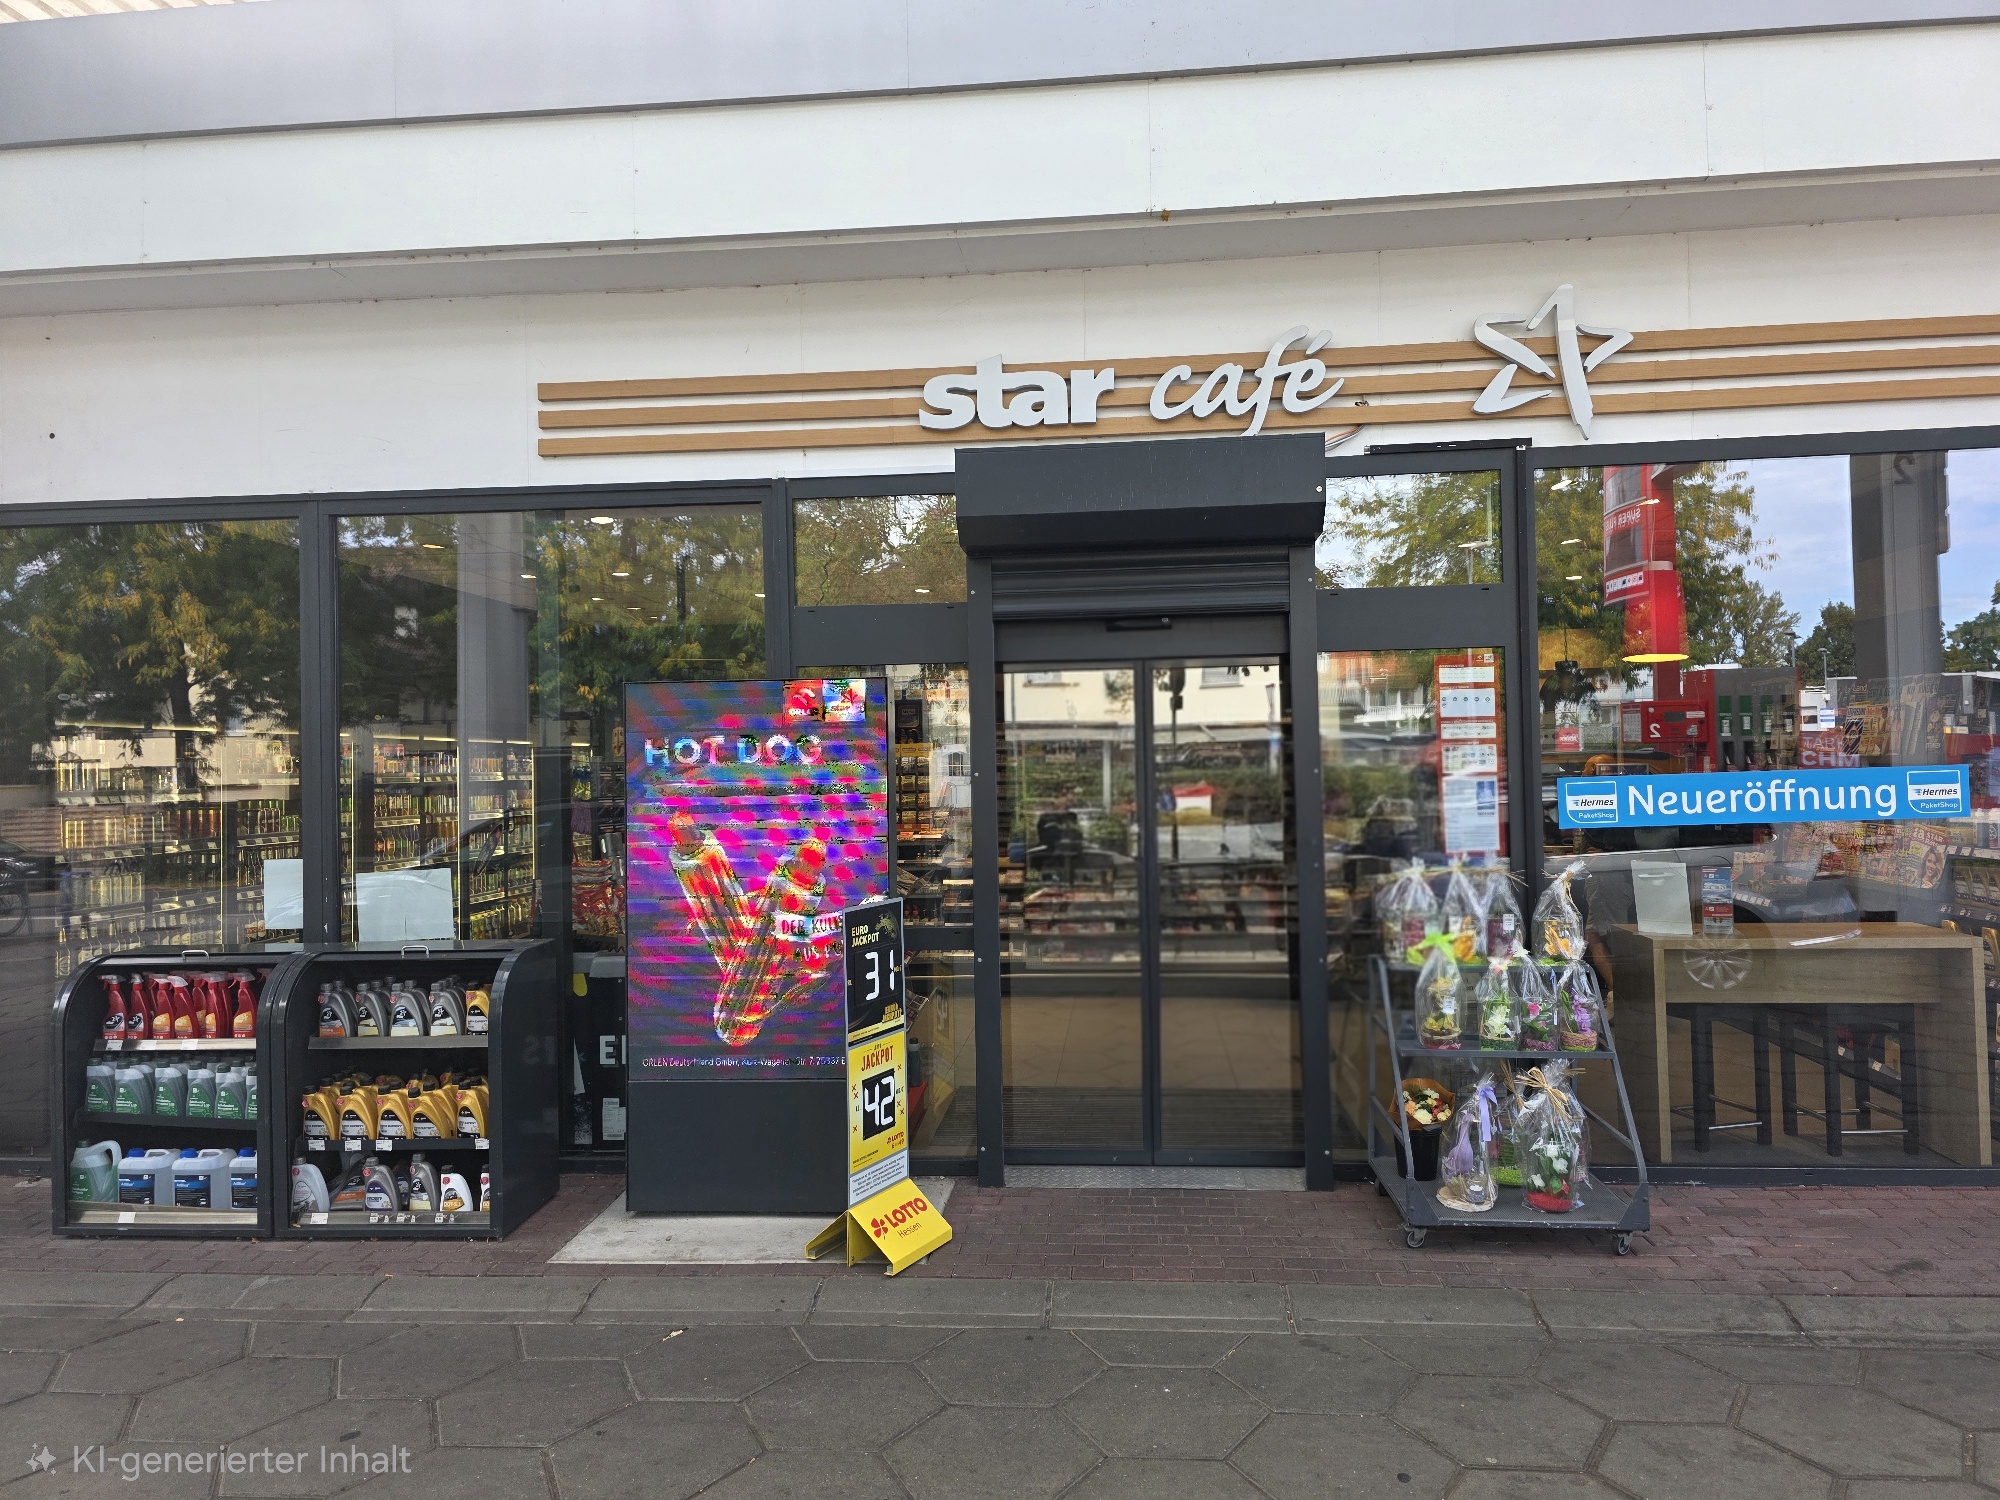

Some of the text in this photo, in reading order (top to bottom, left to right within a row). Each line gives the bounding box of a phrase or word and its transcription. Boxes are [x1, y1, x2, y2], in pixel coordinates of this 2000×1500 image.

[919, 325, 1345, 437] star café
[645, 734, 825, 766] HOT DOG
[1581, 798, 1614, 808] Hermes
[1627, 778, 1897, 818] Neueröffnung
[1922, 787, 1958, 797] Hermes
[1578, 811, 1615, 820] PaketShop
[1920, 801, 1959, 809] PaketShop
[851, 924, 869, 937] EURO
[851, 932, 880, 948] JACKPOT
[865, 949, 895, 1001] 31
[861, 1045, 894, 1072] JACKPOT
[864, 1075, 895, 1127] 42
[883, 1197, 928, 1229] LOTTO
[896, 1222, 923, 1239] Hessen
